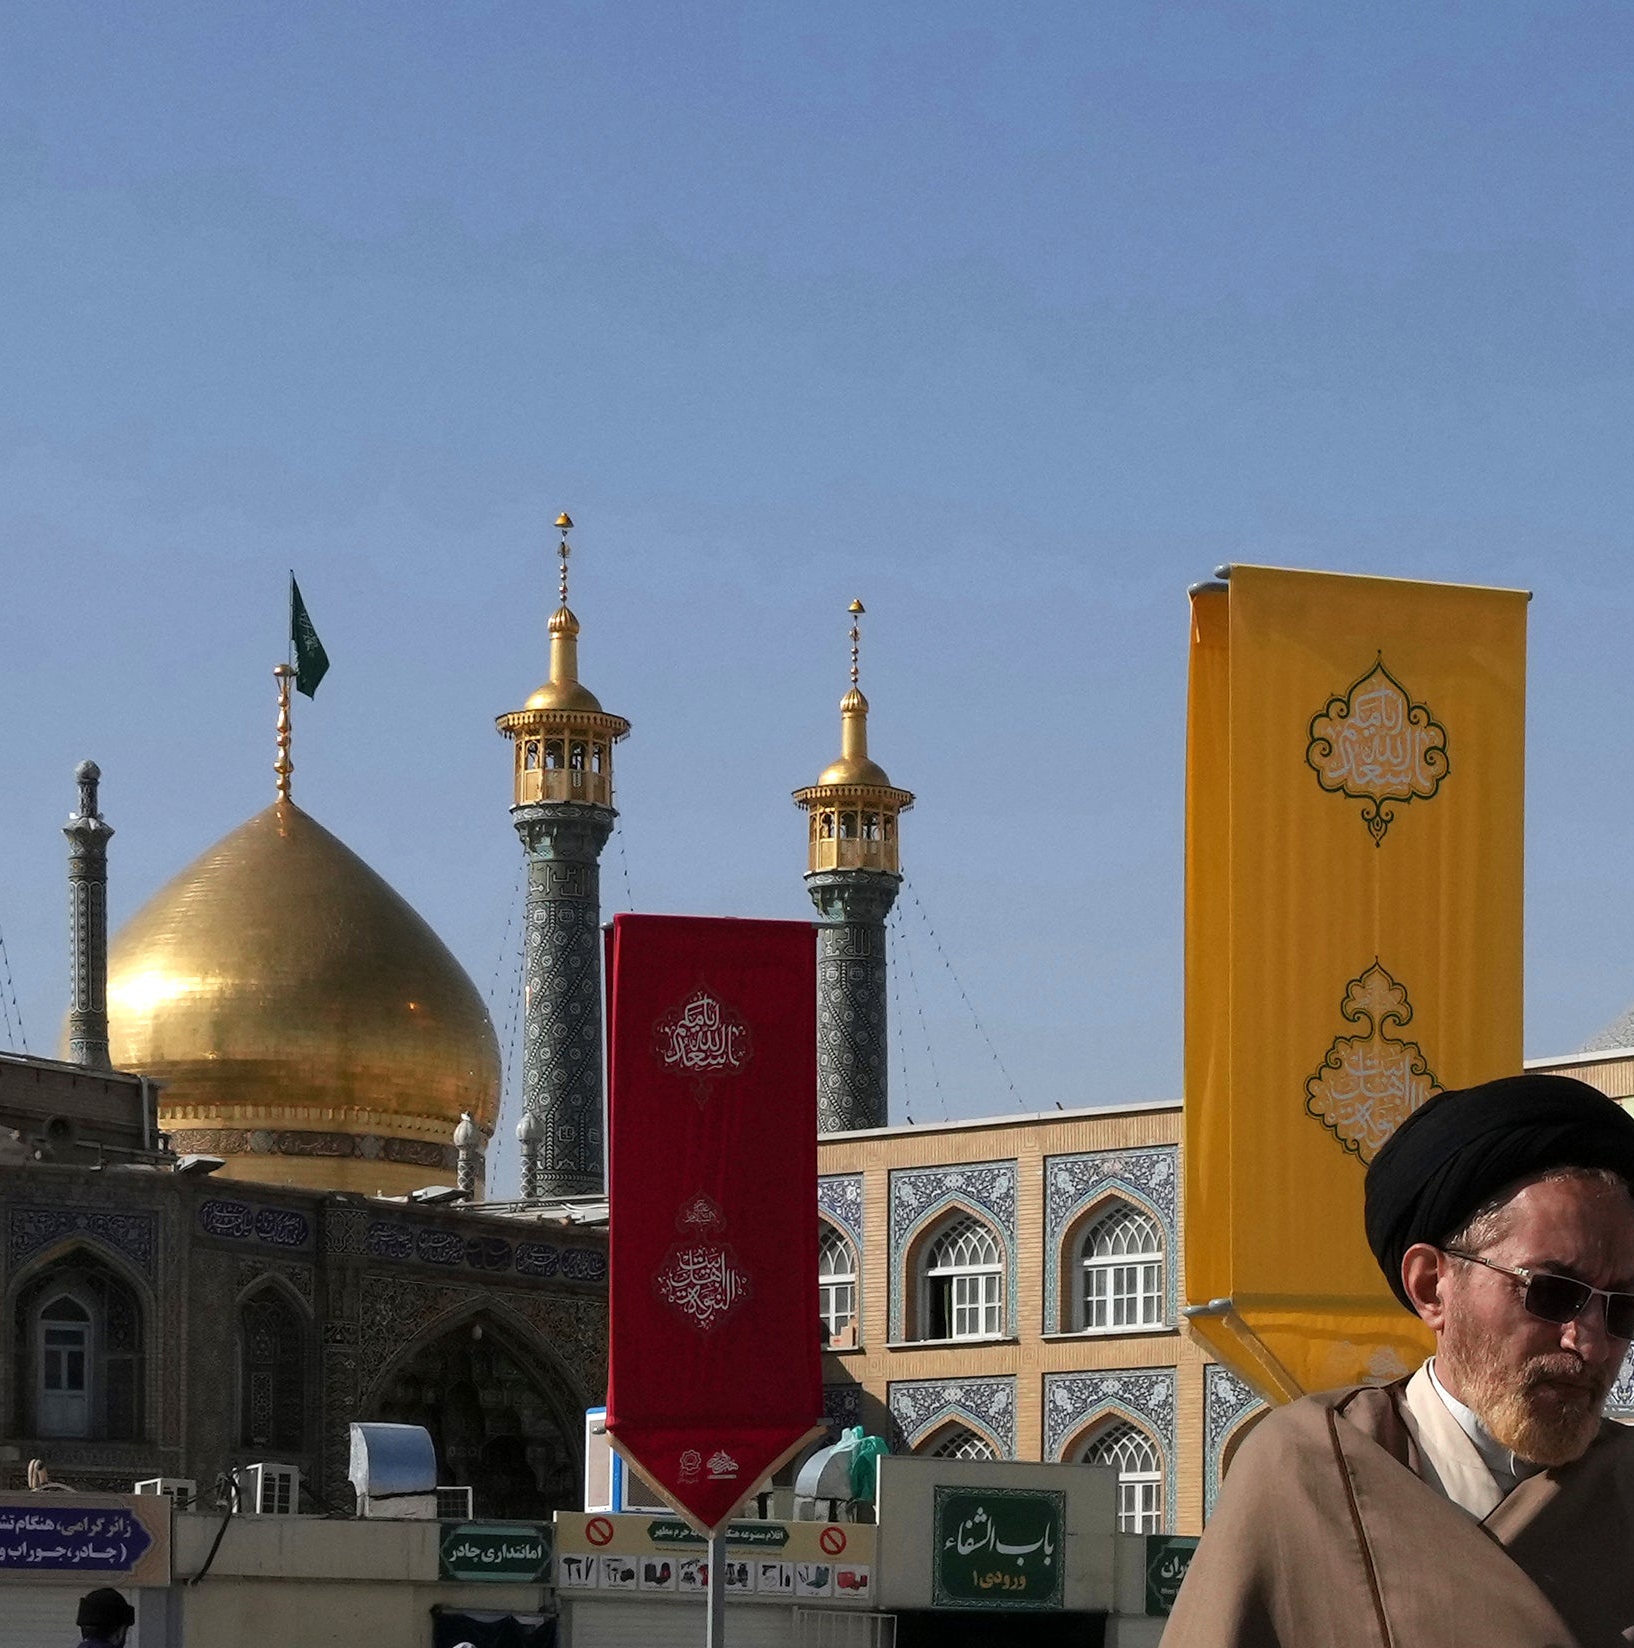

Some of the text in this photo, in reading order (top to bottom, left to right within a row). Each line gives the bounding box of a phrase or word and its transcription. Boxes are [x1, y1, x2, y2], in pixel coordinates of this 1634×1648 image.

[15, 1513, 56, 1536] هنگام
[105, 1515, 133, 1538] زائر
[725, 1528, 741, 1538] هنگ
[943, 1505, 1056, 1567] باب الشفاء
[447, 1541, 544, 1564] امانتداری چادر
[979, 1570, 1028, 1591] ورودی
